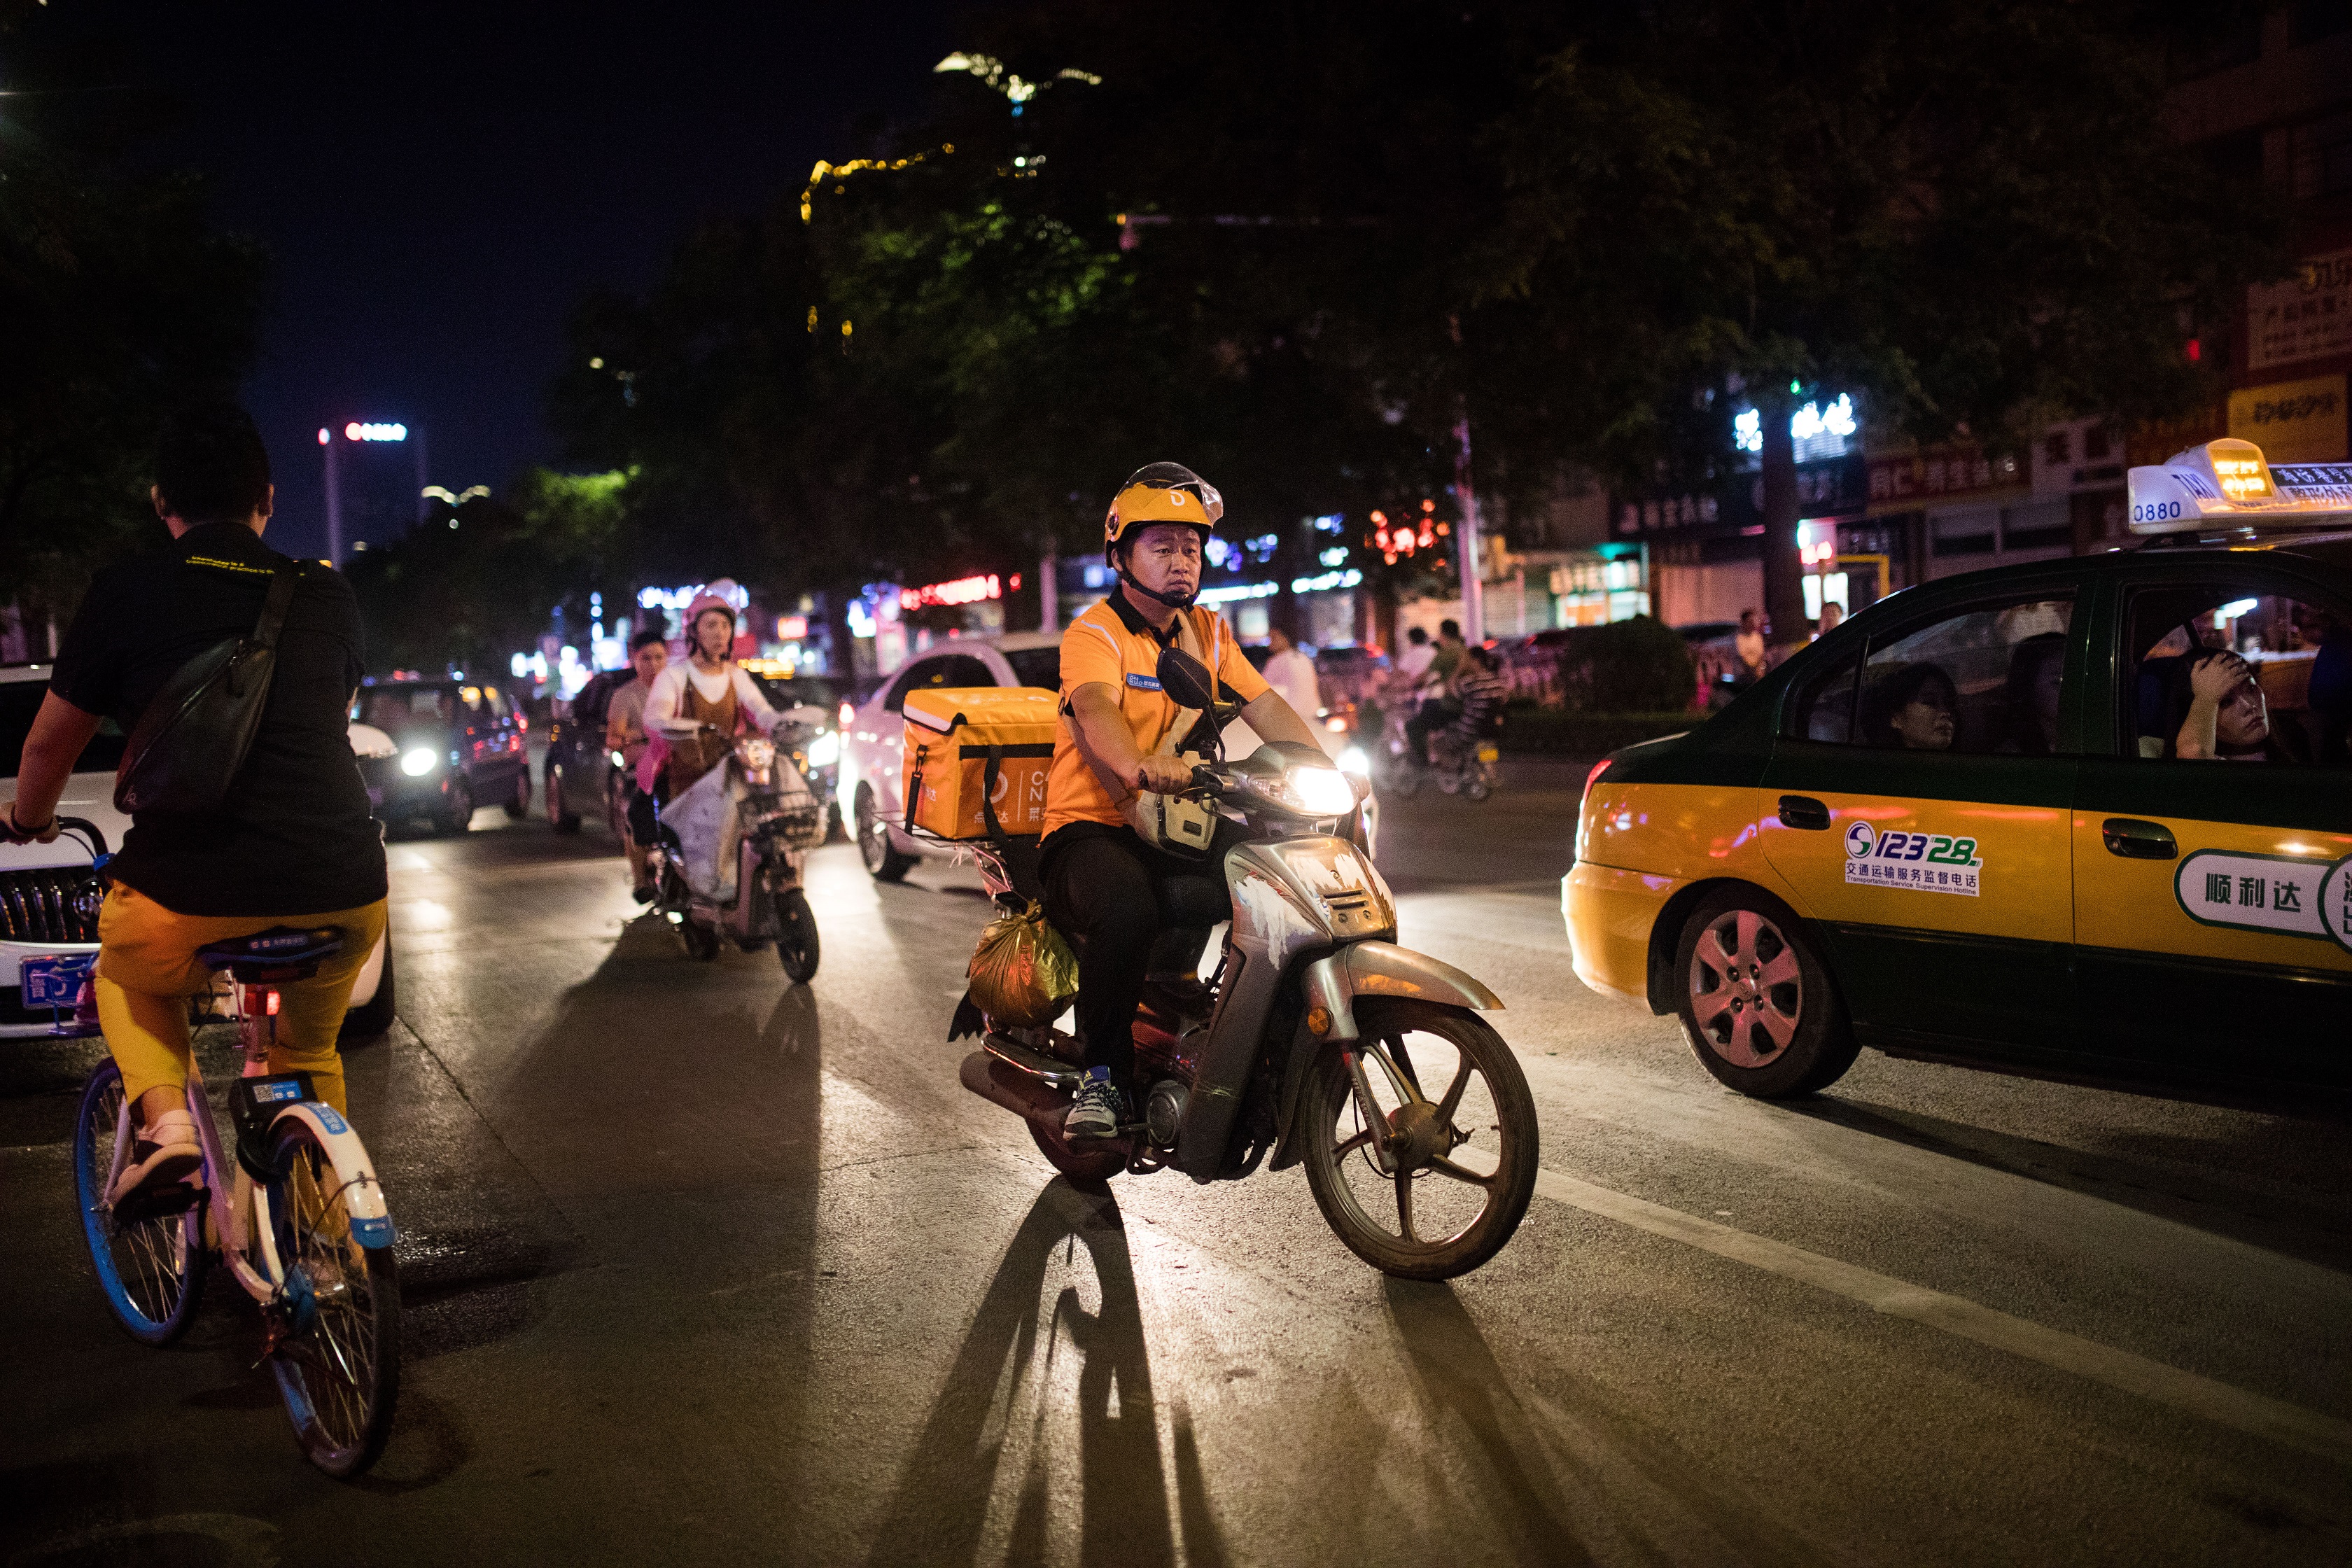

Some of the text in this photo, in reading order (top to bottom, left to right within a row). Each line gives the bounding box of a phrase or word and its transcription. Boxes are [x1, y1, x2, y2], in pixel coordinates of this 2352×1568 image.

[2171, 473, 2216, 500] TAXI
[2134, 501, 2180, 522] 0880
[974, 811, 1009, 823] 点达
[1875, 832, 1980, 867] 12328
[1846, 862, 1976, 888] 交通运输服务监督电话
[1847, 876, 1977, 895] Transportation Service Supervision Hotline
[2205, 873, 2301, 913] 顺利达
